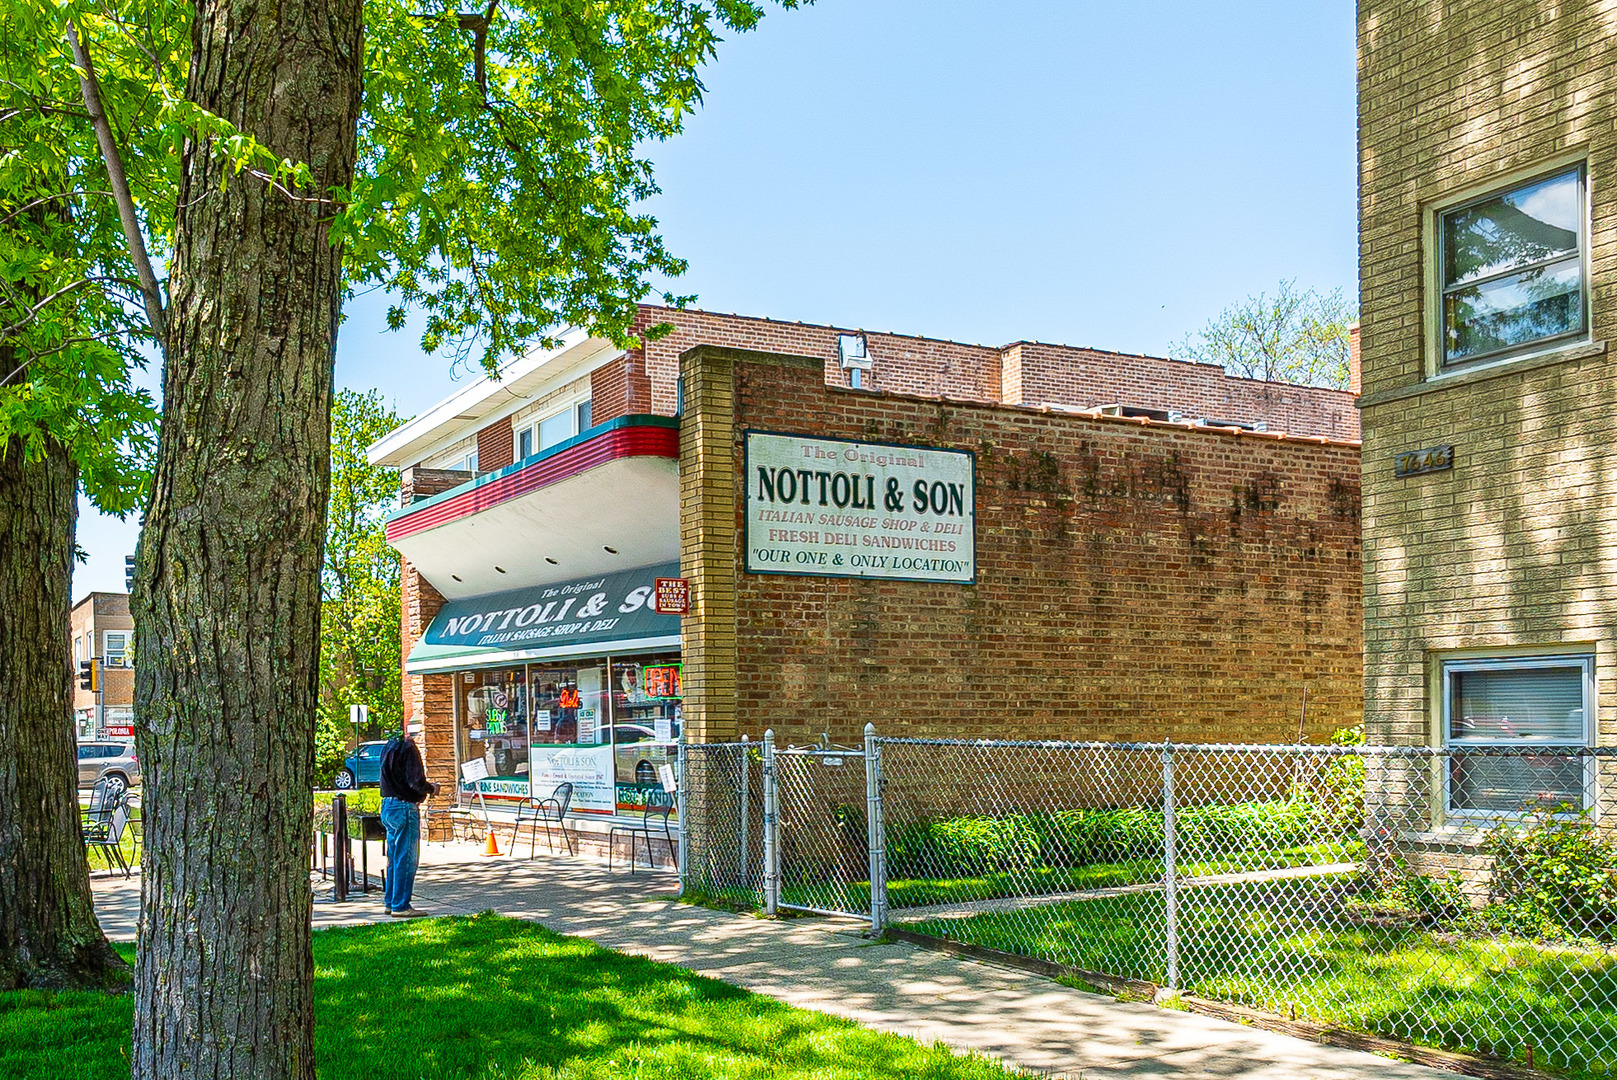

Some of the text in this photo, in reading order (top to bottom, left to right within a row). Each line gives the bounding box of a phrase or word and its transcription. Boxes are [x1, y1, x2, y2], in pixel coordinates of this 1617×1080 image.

[801, 445, 925, 468] The Original
[1400, 450, 1445, 472] 7646
[756, 465, 965, 517] NOTTOLI & SON
[758, 509, 964, 535] ITALIAN SAUSAGE SHOP & DELI
[768, 529, 957, 552] FRESH DELI SANDWICHES
[752, 548, 970, 573] "OUR ONE & ONLY LOCATION"
[541, 578, 606, 599] The Original
[658, 586, 687, 595] BEST
[660, 580, 684, 588] THE
[440, 597, 577, 638] NOTTOLI
[576, 592, 609, 619] &
[477, 618, 620, 646] ITALIAN SAUSAGE SHOP & DELI
[645, 668, 683, 697] OPEN
[493, 782, 529, 795] SANDWICHES
